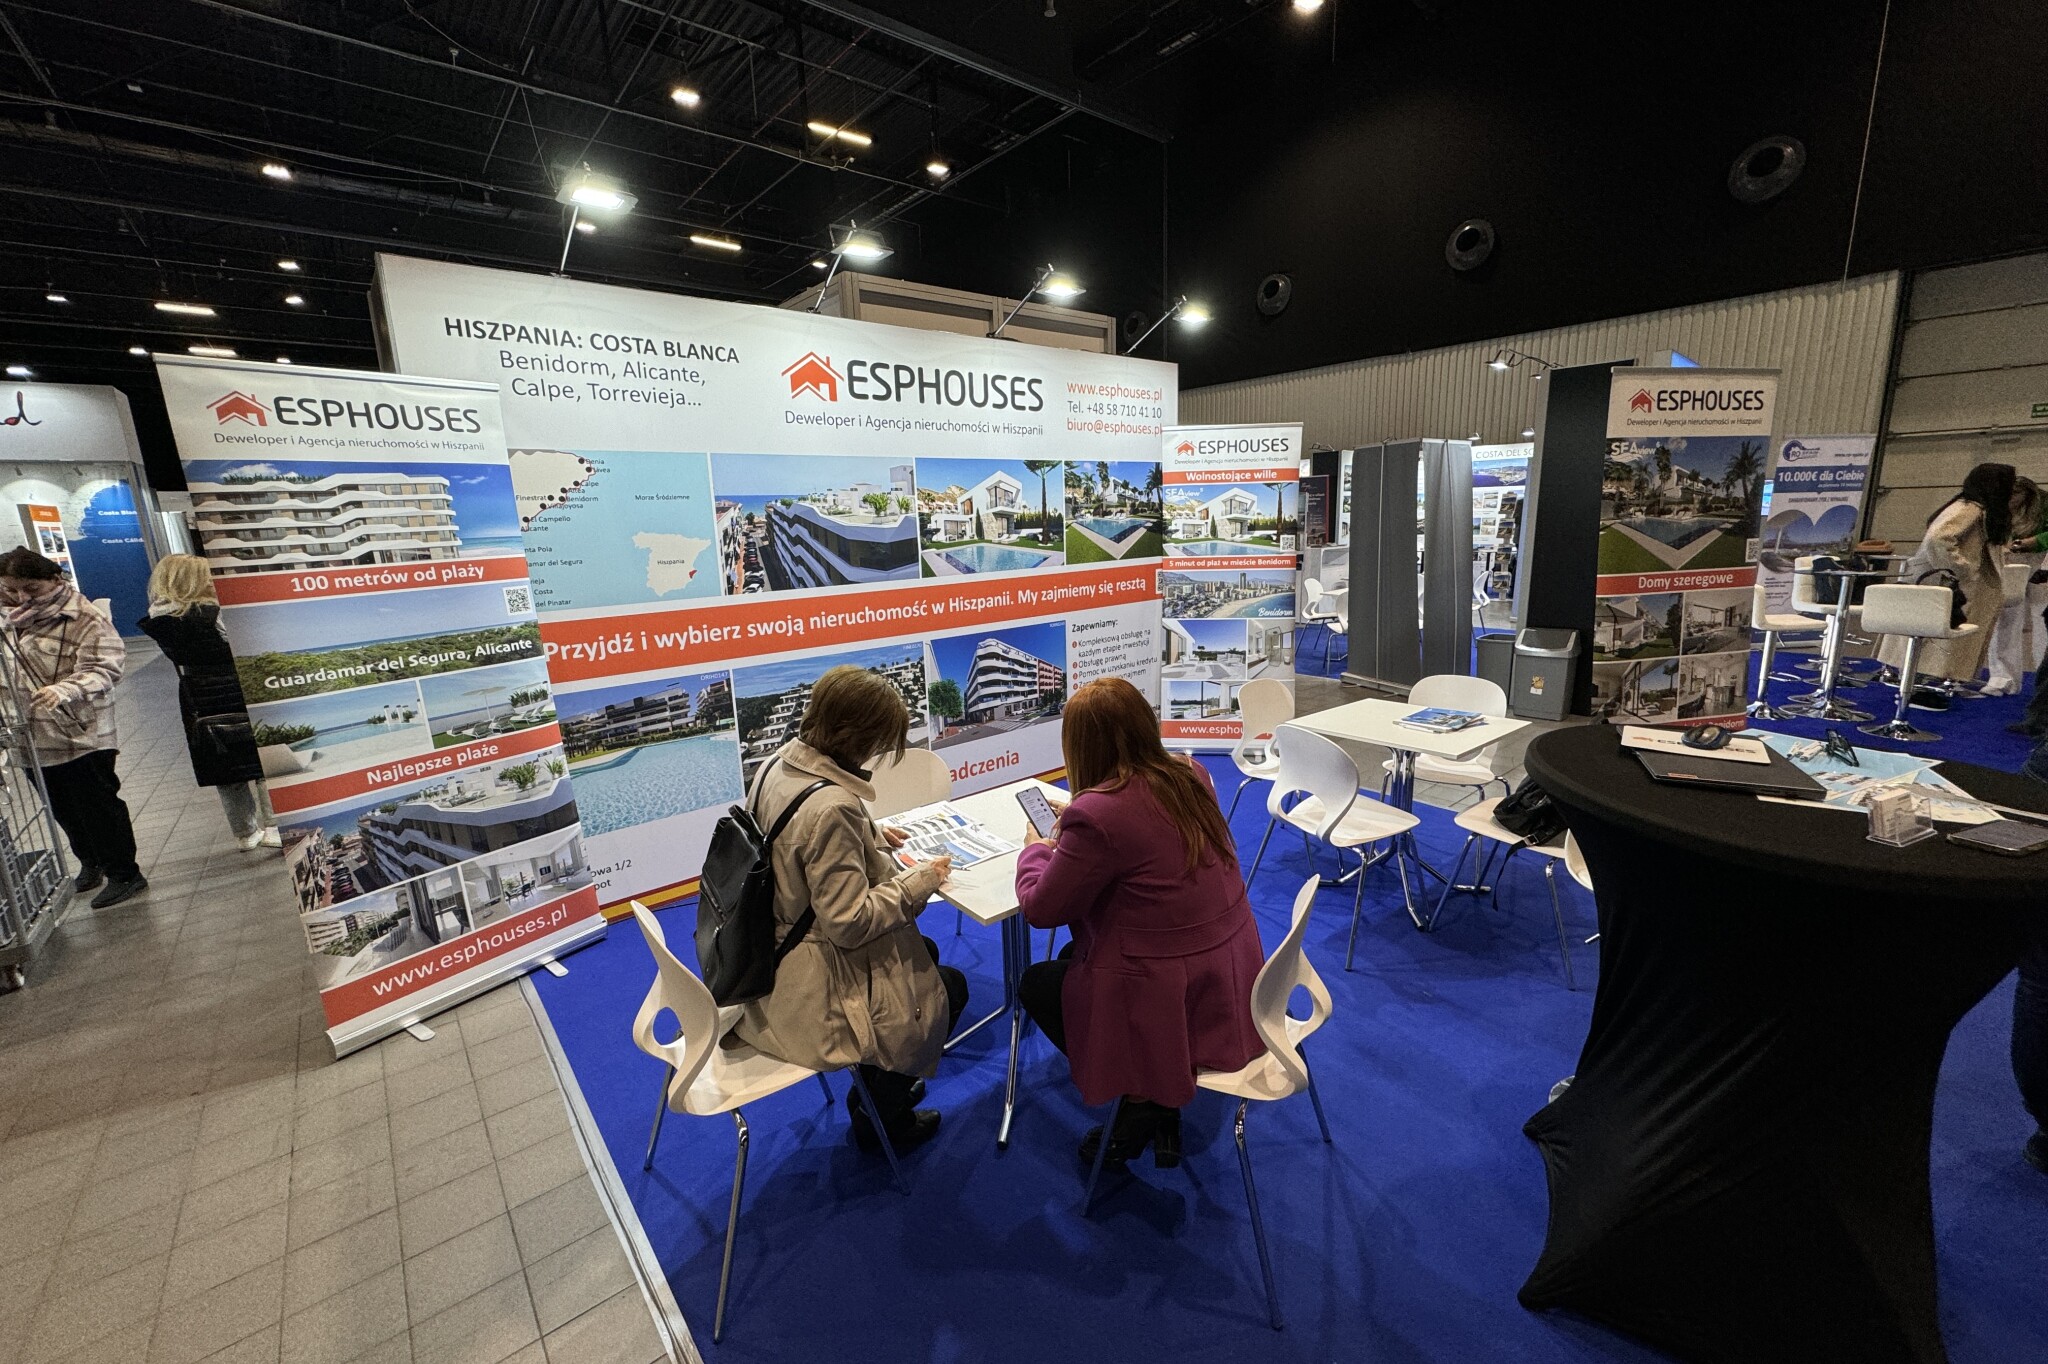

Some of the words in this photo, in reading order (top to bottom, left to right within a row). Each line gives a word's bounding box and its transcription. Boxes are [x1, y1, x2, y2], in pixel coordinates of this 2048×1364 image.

[443, 316, 584, 350] HISZPANIA:
[589, 332, 658, 357] COSTA
[663, 340, 740, 364] BLANCA
[499, 350, 617, 380] Benidorm,
[622, 360, 707, 388] Alicante,
[511, 377, 582, 403] Calpe,
[586, 382, 702, 408] Torrevieja...
[846, 359, 1044, 412] ESPHOUSES
[1066, 381, 1163, 404] www.esphouses.pl
[1067, 400, 1084, 414] Tel.
[1086, 402, 1105, 415] +48
[1106, 403, 1118, 416] 58
[1120, 404, 1137, 417] 710
[1138, 406, 1149, 418] 41
[1151, 407, 1162, 419] 10
[1656, 390, 1765, 411] ESPHOUSES
[273, 395, 482, 434] ESPHOUSES
[784, 410, 857, 427] Deweloper
[858, 415, 863, 427] i
[865, 416, 912, 434] Agencja
[914, 419, 991, 434] nieruchomości
[992, 424, 1001, 433] w
[1003, 422, 1044, 438] Hiszpanii
[1066, 417, 1163, 438] biuro@esphouses.pl
[214, 432, 287, 447] Deweloper
[290, 436, 295, 446] i
[298, 435, 345, 450] Agencja
[348, 438, 429, 449] nieruchomości
[442, 440, 485, 452] Hiszpanii
[1198, 438, 1289, 455] ESPHOUSES
[1475, 450, 1504, 459] COSTA
[1506, 449, 1521, 457] DEL
[1523, 448, 1534, 456] SO
[1185, 471, 1252, 482] Wolnostojące
[1254, 469, 1278, 479] wille
[1778, 471, 1818, 482] 10.000€
[1819, 470, 1834, 481] dla
[1835, 469, 1865, 481] Ciebie
[538, 515, 571, 523] Campello
[560, 558, 583, 567] Segura
[657, 558, 685, 566] Hiszpania
[1175, 559, 1196, 567] minut
[1197, 559, 1206, 567] od
[1230, 558, 1257, 567] mieście
[1257, 556, 1291, 566] Benidorm
[289, 575, 329, 593] 100
[334, 570, 409, 589] metrów
[413, 565, 436, 582] od
[441, 563, 485, 581] plaży
[1638, 575, 1671, 590] Domy
[1673, 572, 1734, 589] szeregowe
[533, 588, 553, 596] Costa
[547, 599, 571, 607] Pinatar
[543, 632, 635, 663] Przyjdź
[641, 630, 649, 650] i
[653, 622, 742, 651] wybierz
[746, 614, 805, 639] swoją
[809, 598, 929, 631] nieruchomość
[931, 600, 945, 615] w
[949, 590, 1015, 613] Hiszpanii.
[1017, 588, 1038, 609] My
[1041, 582, 1097, 603] zajmiemy
[1098, 579, 1114, 597] się
[1116, 577, 1147, 596] resztą
[1071, 619, 1119, 634] Zapewniamy:
[1078, 633, 1120, 648] Kompleksową
[1120, 630, 1143, 641] obsługę
[1143, 628, 1151, 636] na
[1102, 644, 1122, 655] etapie
[1122, 637, 1150, 651] inwestycji
[263, 662, 375, 690] Guardamar
[377, 656, 405, 672] del
[408, 649, 472, 669] Segura,
[474, 637, 533, 658] Alicante
[1078, 657, 1104, 670] Obsługę
[1104, 653, 1127, 665] prawną
[1078, 668, 1100, 679] Pomoc
[1107, 662, 1136, 673] uzyskaniu
[1136, 656, 1158, 668] kredytu
[1179, 724, 1243, 736] www.espho
[366, 754, 453, 786] Najlepsze
[457, 743, 500, 768] plaże
[950, 749, 1020, 782] adczenia
[591, 865, 612, 878] owa
[614, 859, 633, 872] 1/2
[594, 879, 612, 891] pot
[371, 903, 569, 997] www.esphouses.pl
